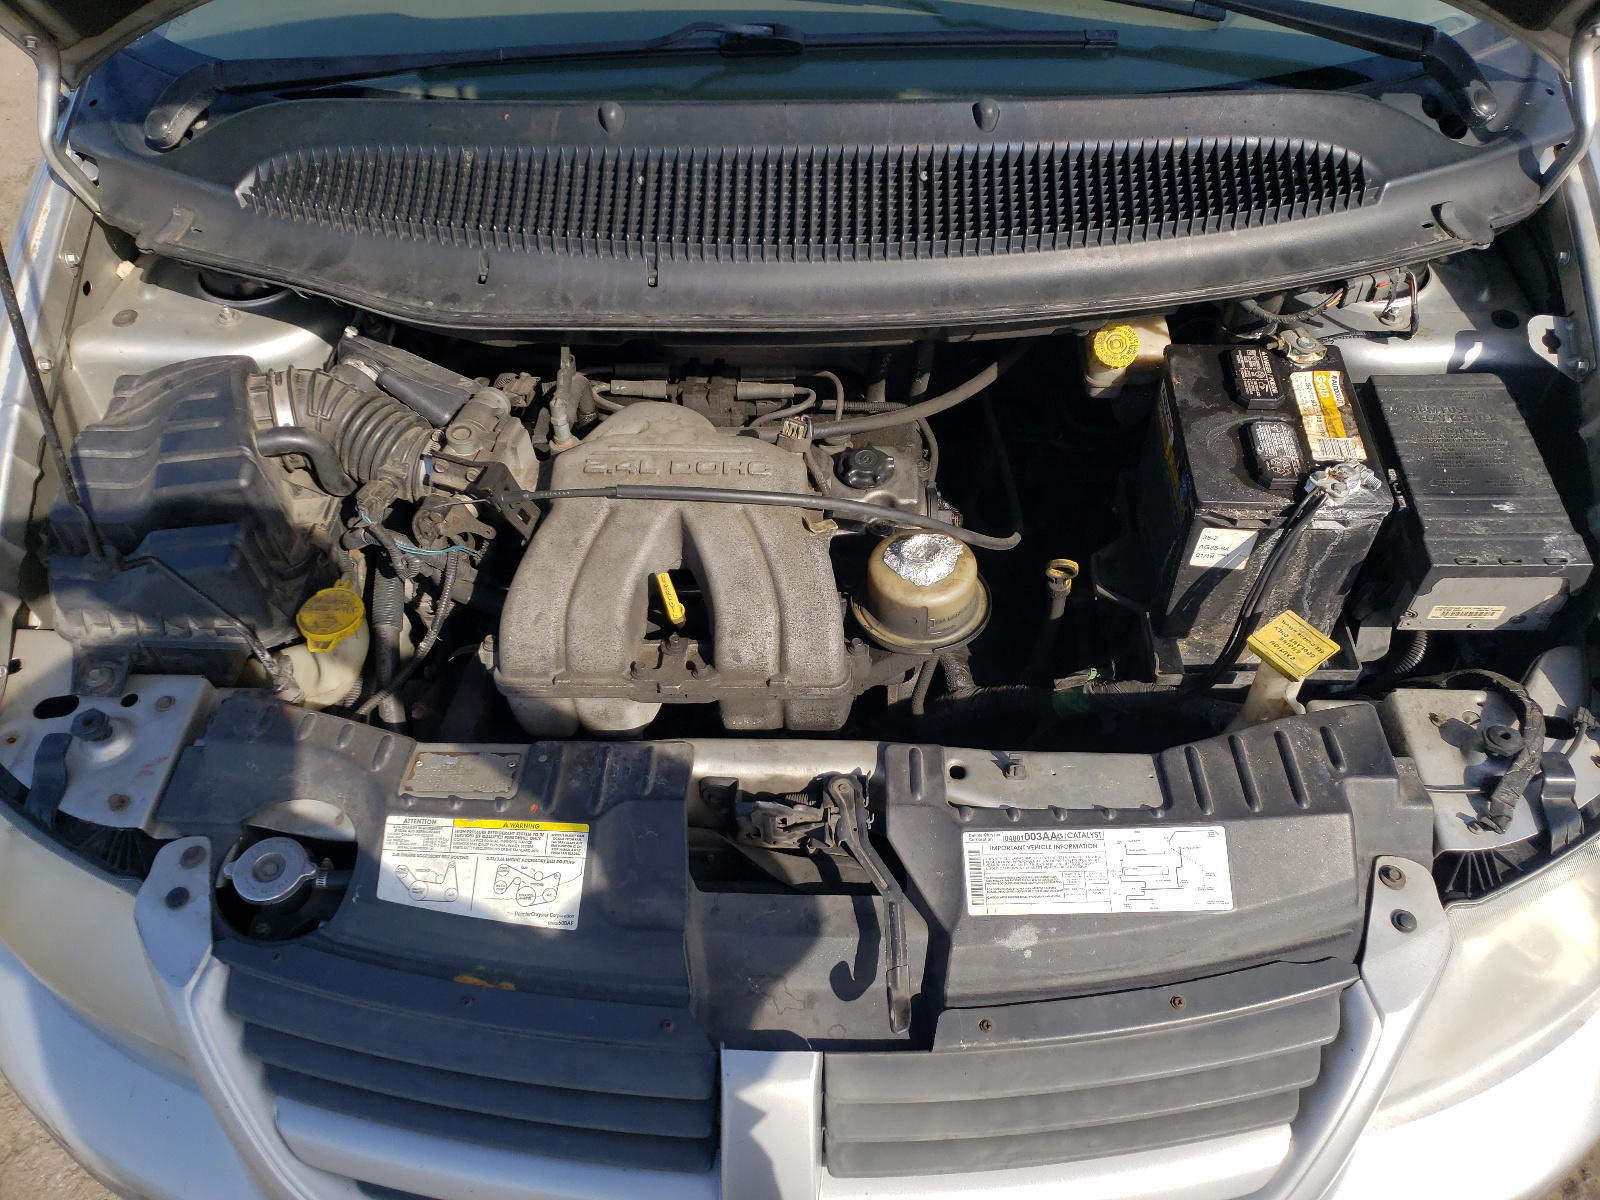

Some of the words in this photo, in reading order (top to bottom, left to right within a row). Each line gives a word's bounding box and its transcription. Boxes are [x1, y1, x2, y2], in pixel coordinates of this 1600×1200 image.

[583, 458, 660, 475] 2.4L
[669, 460, 772, 476] DOHC
[1066, 831, 1102, 839] CATALYST
